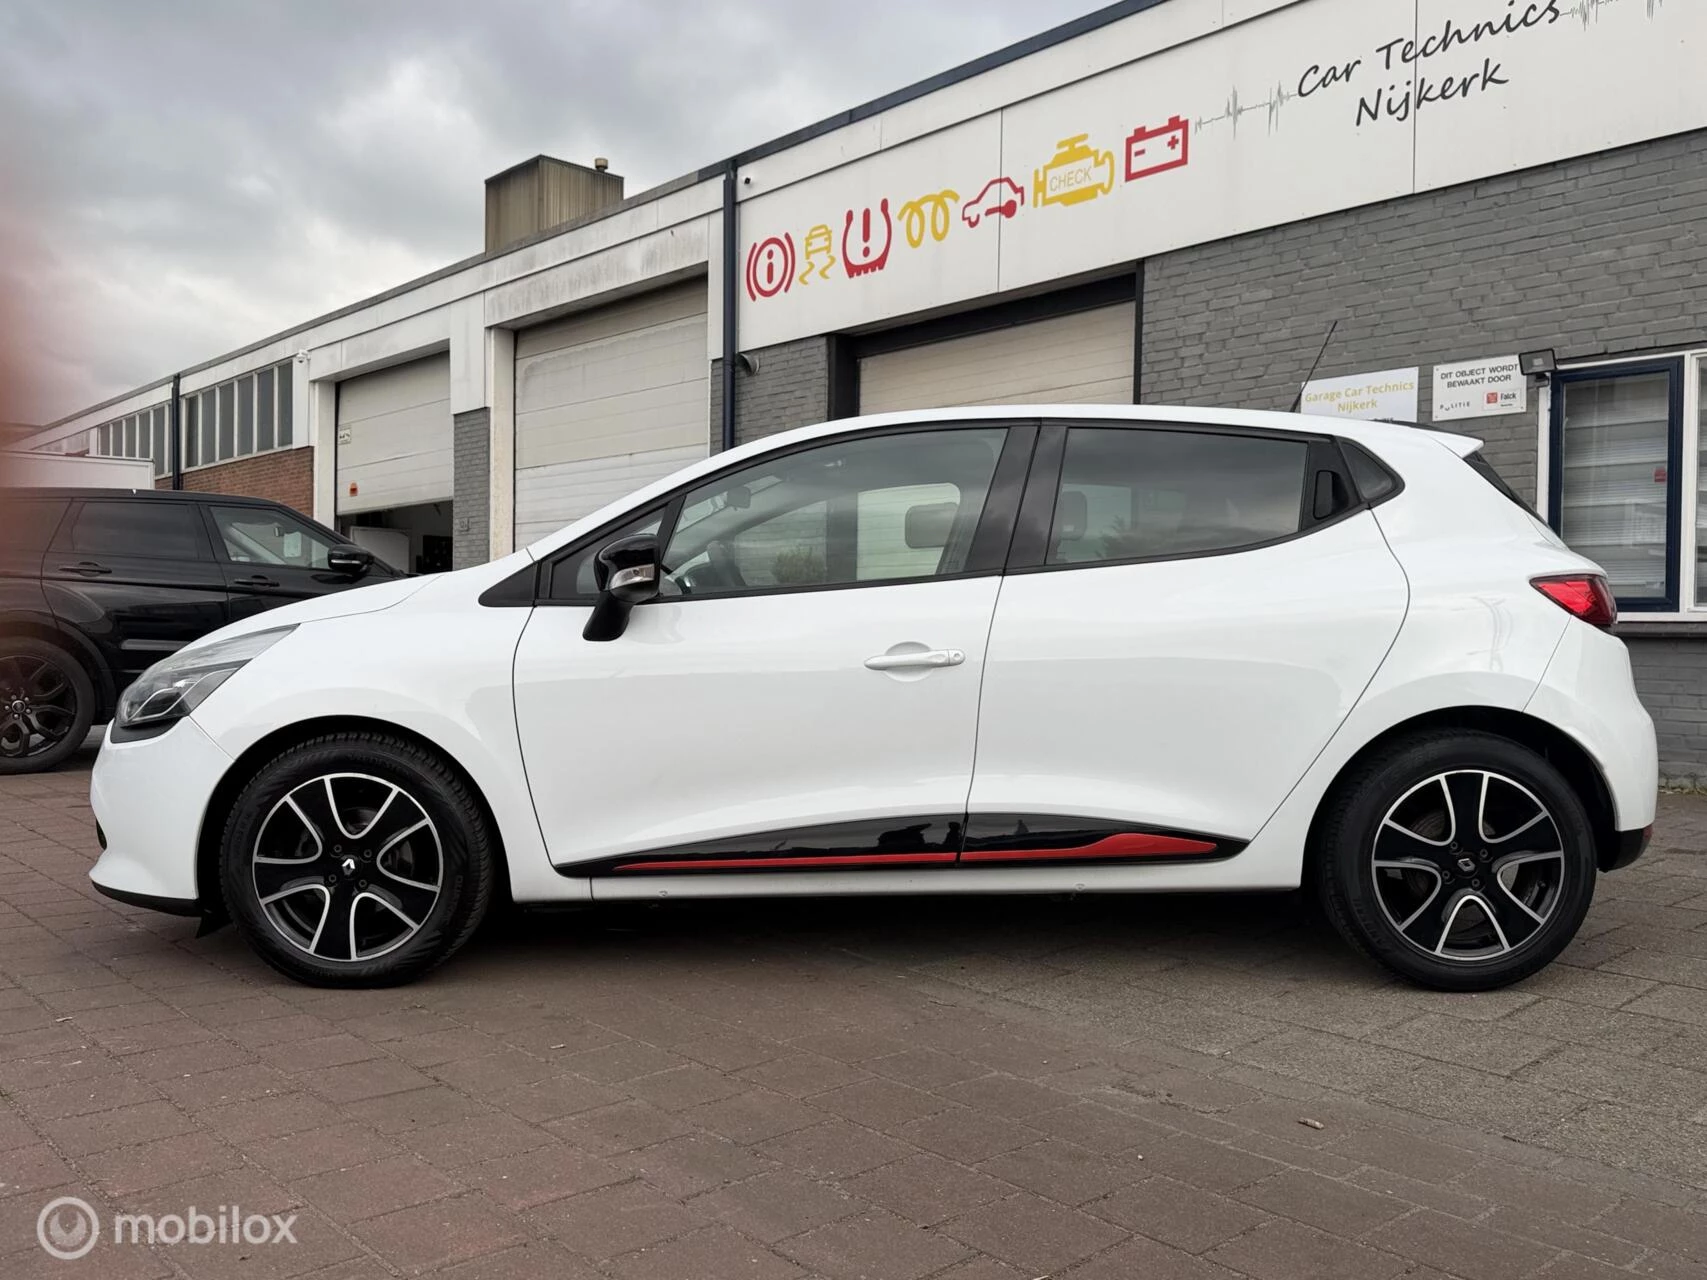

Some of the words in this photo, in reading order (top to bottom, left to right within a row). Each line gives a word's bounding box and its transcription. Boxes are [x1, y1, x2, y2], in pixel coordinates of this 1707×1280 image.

[1297, 59, 1362, 98] Car
[1375, 0, 1561, 71] Technics
[1355, 58, 1509, 127] Nijkerk
[1049, 165, 1092, 192] CHECK
[1440, 371, 1453, 380] DIT
[1455, 367, 1486, 378] OBJECT
[1488, 363, 1519, 374] WORDT
[1447, 377, 1486, 388] BEWAAKT
[1487, 374, 1512, 384] DOOR
[1304, 391, 1342, 403] Garage
[1344, 386, 1363, 398] Car
[1366, 381, 1415, 395] Technics
[1337, 399, 1378, 413] Nijkerk
